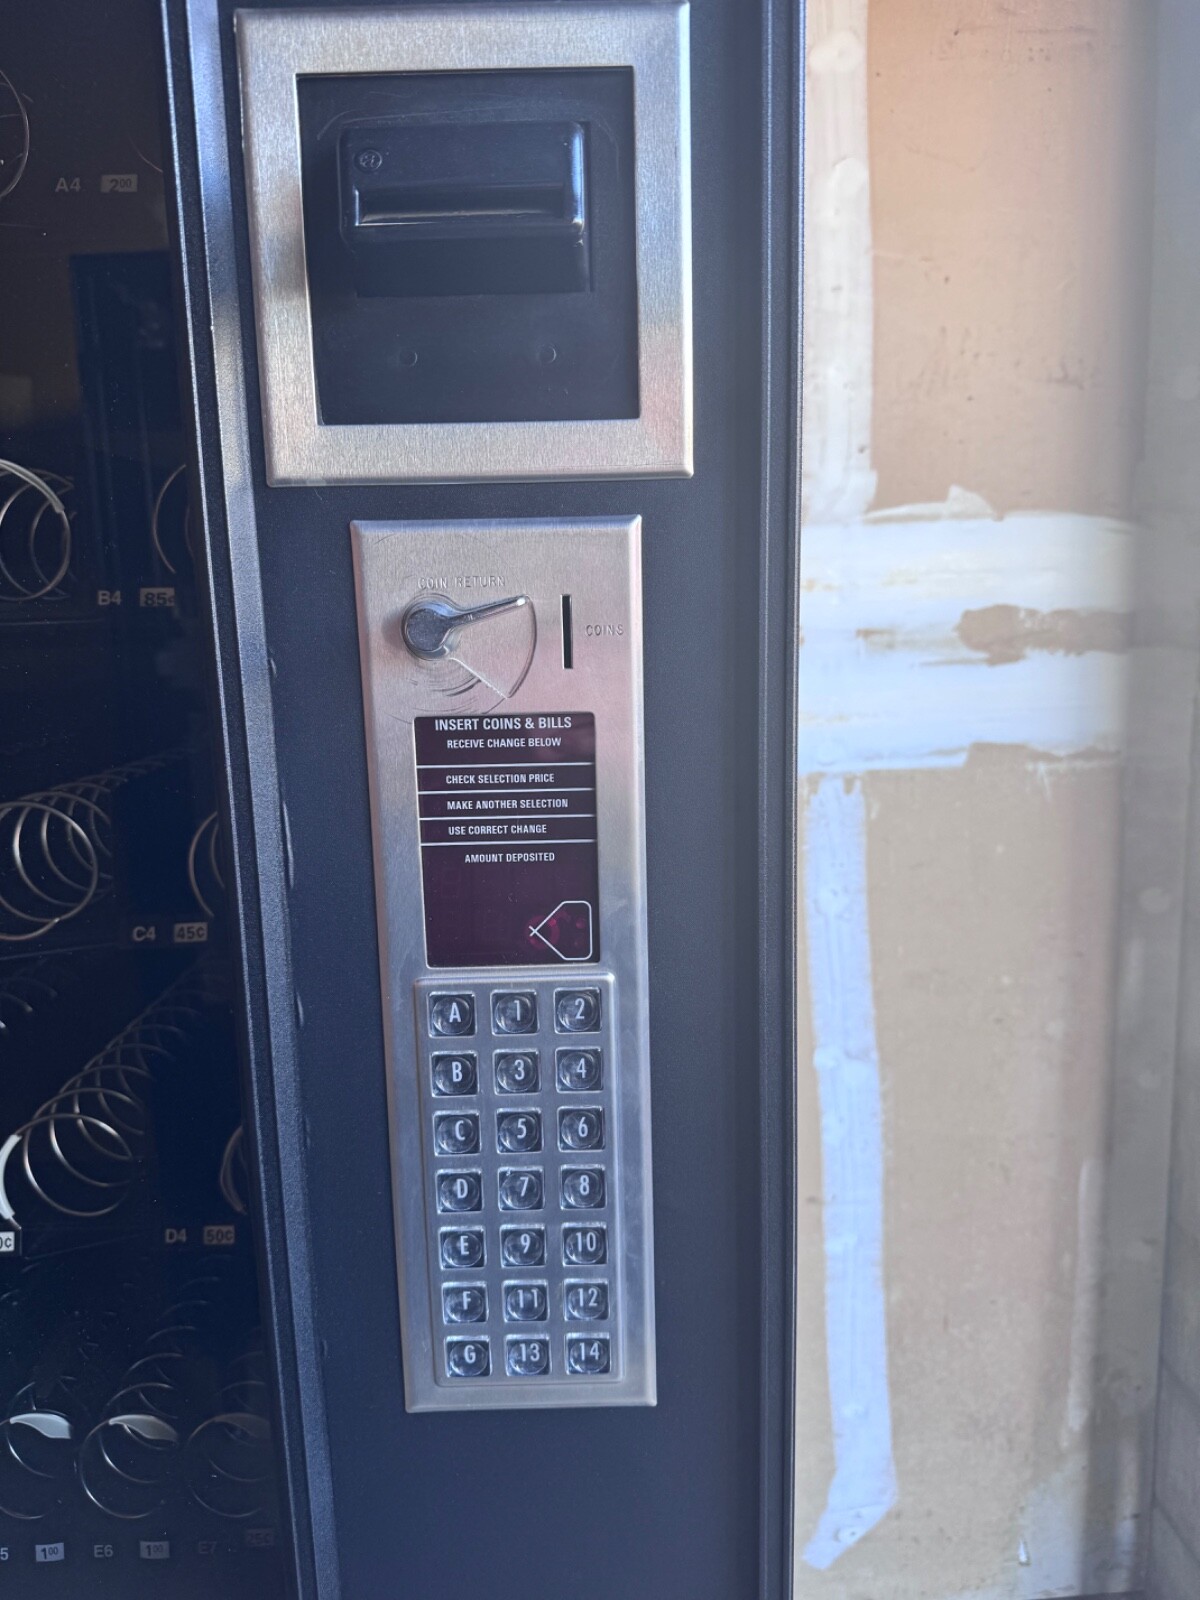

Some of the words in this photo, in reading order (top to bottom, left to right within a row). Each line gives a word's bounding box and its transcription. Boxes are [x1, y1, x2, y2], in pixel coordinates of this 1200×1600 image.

[54, 177, 81, 192] A4
[417, 576, 447, 589] COIN
[453, 575, 506, 588] RETURN
[97, 590, 122, 605] B4
[585, 624, 624, 636] COINS
[435, 718, 480, 732] INSERT
[482, 717, 522, 731] COINS
[525, 717, 535, 729] &
[538, 716, 572, 729] BILLS
[447, 738, 486, 749] RECEIVE
[487, 737, 526, 748] CHANGE
[528, 737, 562, 747] BELOW
[446, 774, 476, 784] CHECK
[478, 774, 527, 784] SELECTION
[528, 773, 555, 783] PRICE
[447, 800, 474, 810] MAKE
[475, 799, 518, 809] ANOTHER
[519, 798, 569, 809] SELECTION
[448, 826, 467, 836] USE
[468, 825, 509, 835] CORRECT
[510, 824, 547, 834] CHANGE
[464, 853, 504, 863] AMOUNT
[506, 852, 555, 863] DEPOSITED
[131, 926, 156, 941] C4
[449, 1002, 462, 1023] A
[514, 1000, 521, 1021] 1
[574, 998, 585, 1020] 2
[452, 1061, 463, 1082] B
[514, 1059, 525, 1080] 3
[576, 1057, 587, 1079] 4
[454, 1120, 466, 1141] C
[516, 1118, 527, 1139] 5
[578, 1116, 589, 1138] 6
[457, 1178, 468, 1199] D
[520, 1177, 529, 1197] 7
[579, 1175, 590, 1196] 8
[164, 1228, 187, 1243] D4
[460, 1235, 470, 1256] E
[520, 1233, 531, 1254] 9
[575, 1231, 597, 1252] 10
[462, 1291, 471, 1311] F
[517, 1289, 538, 1309] 11
[578, 1287, 598, 1307] 12
[464, 1345, 476, 1364] G
[520, 1343, 540, 1362] 13
[579, 1342, 600, 1361] 14
[93, 1544, 114, 1558] E6
[198, 1540, 218, 1554] E7
